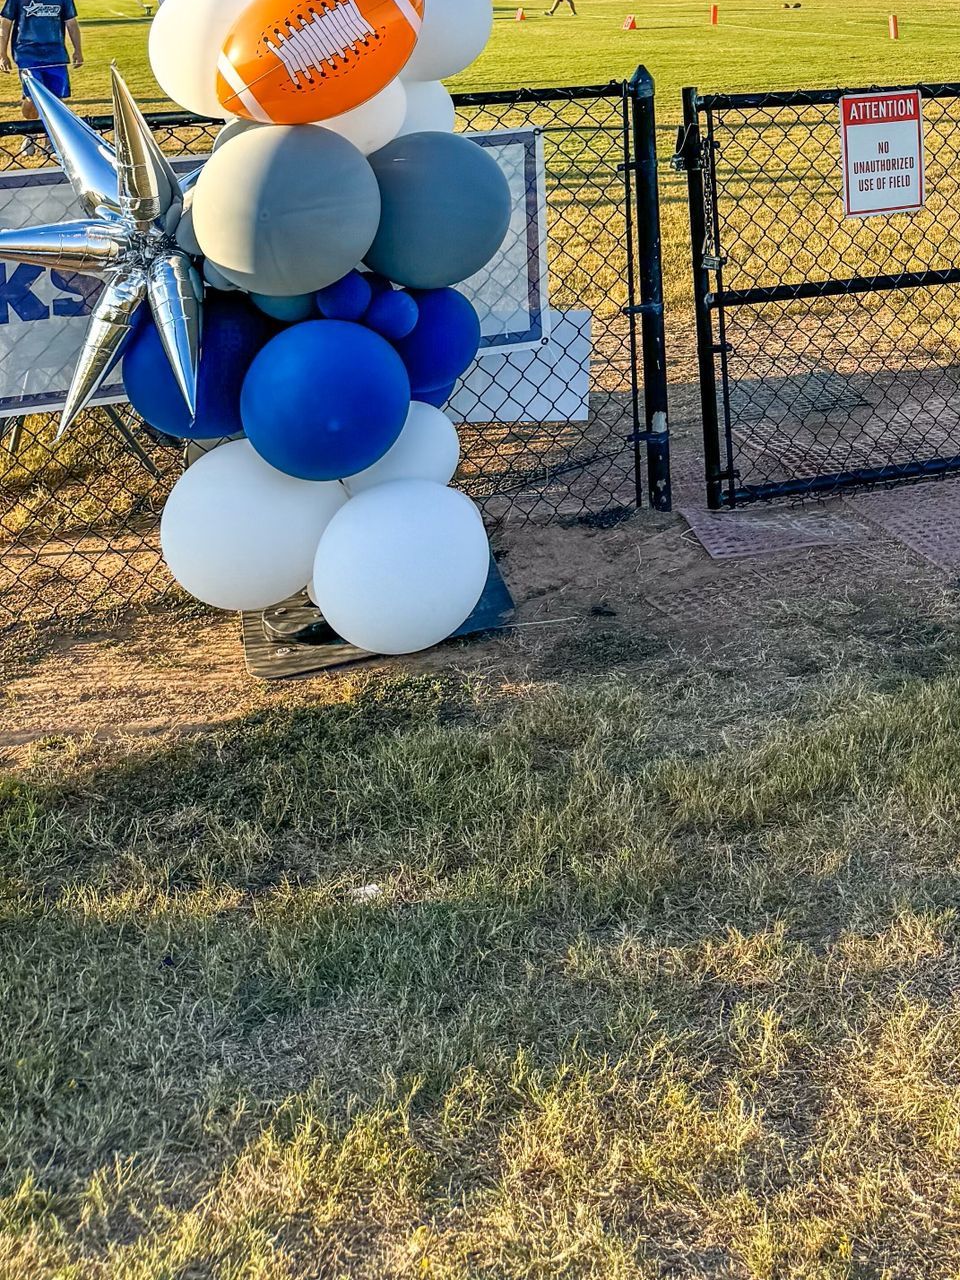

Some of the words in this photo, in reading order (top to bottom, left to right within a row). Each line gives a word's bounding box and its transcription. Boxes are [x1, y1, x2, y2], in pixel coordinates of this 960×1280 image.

[850, 99, 914, 120] ATTENTION
[878, 141, 889, 153] NO
[853, 157, 914, 174] UNAUTHORIZED
[858, 178, 874, 191] USE
[877, 177, 886, 189] OF
[889, 175, 911, 188] FIELD
